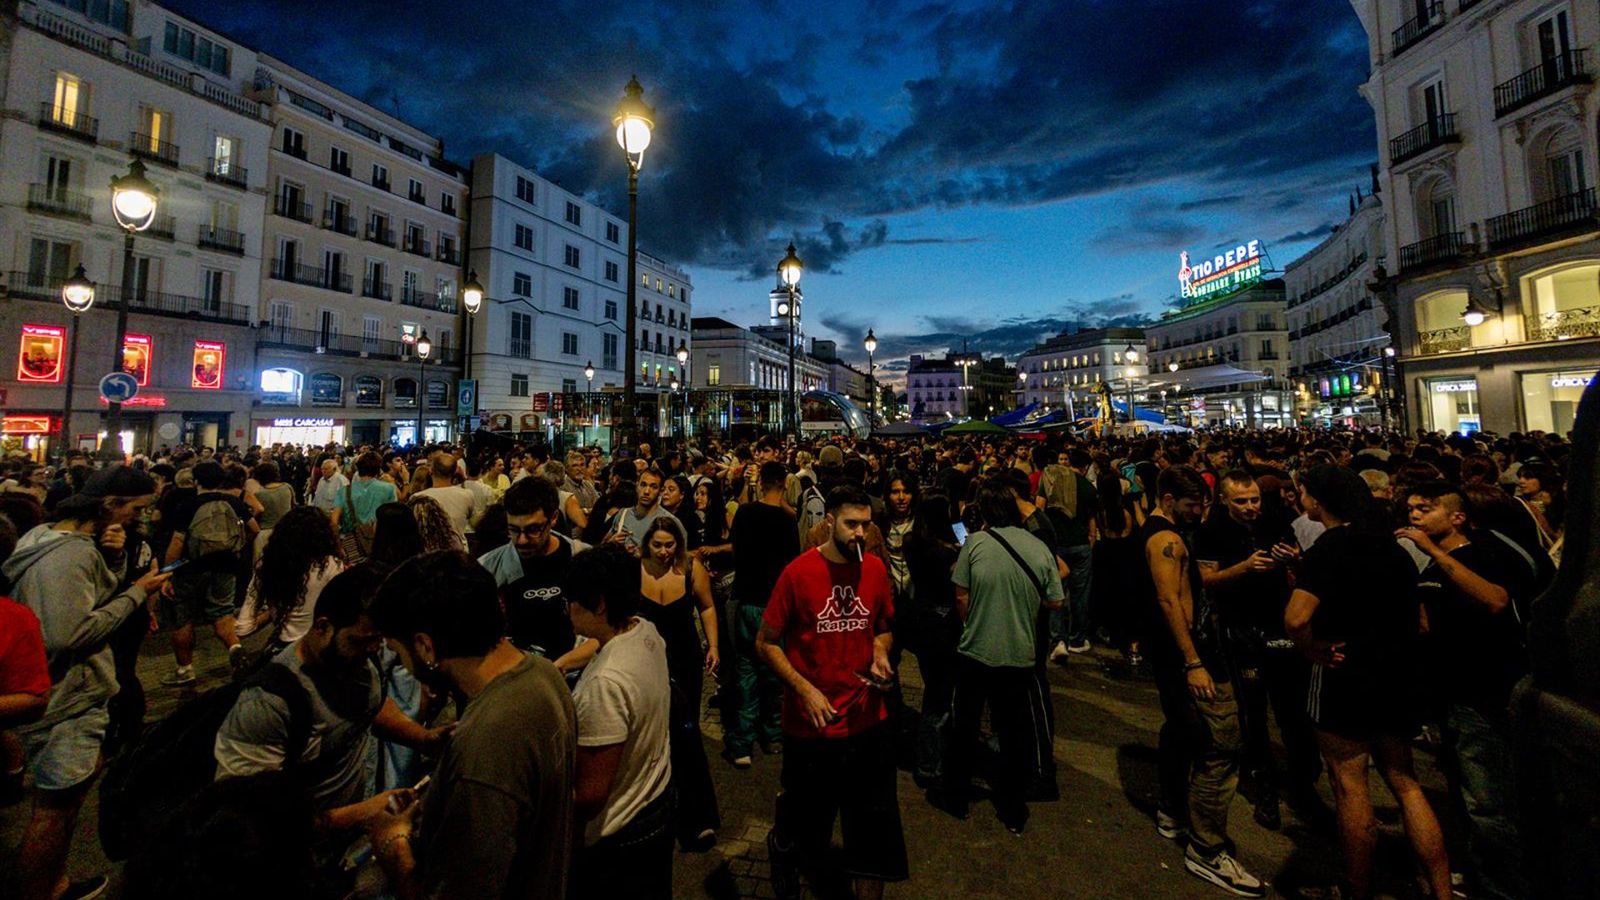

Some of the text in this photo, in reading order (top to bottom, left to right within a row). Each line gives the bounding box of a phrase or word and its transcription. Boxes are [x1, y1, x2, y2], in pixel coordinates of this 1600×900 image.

[1192, 261, 1212, 280] TIO
[1215, 240, 1259, 271] PEPE
[817, 619, 868, 633] Kappa
